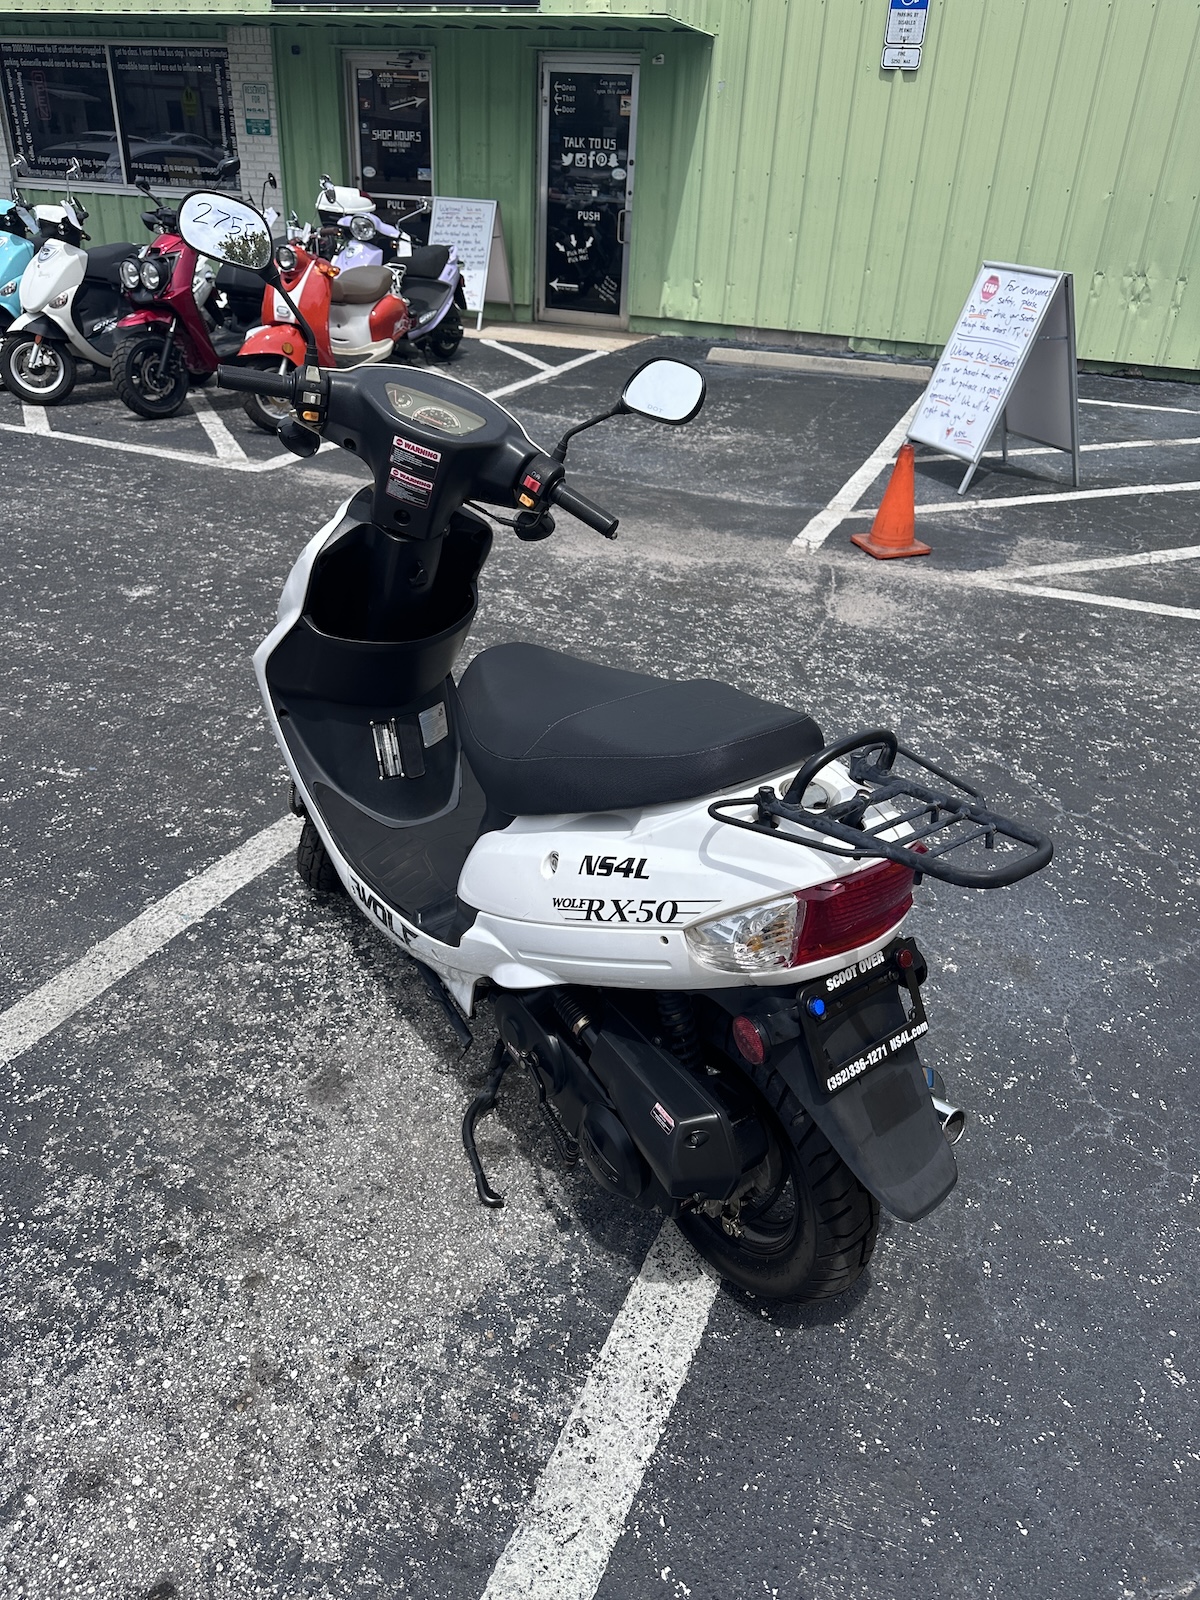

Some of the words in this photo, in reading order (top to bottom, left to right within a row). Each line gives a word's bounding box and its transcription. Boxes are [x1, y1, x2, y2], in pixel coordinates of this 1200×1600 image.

[245, 86, 266, 94] RESERVED
[561, 83, 577, 92] Open
[562, 106, 576, 114] Door
[372, 130, 392, 140] SHOP
[394, 131, 422, 142] HOURS
[563, 136, 586, 149] TALK
[589, 137, 601, 149] TO
[603, 138, 617, 151] US
[387, 200, 406, 210] PULL
[577, 211, 600, 221] PUSH
[983, 282, 998, 294] STOP
[1004, 279, 1020, 292] For
[950, 343, 974, 358] Welcome
[975, 348, 989, 362] back
[647, 404, 664, 413] DOT
[404, 442, 438, 460] WARNING
[400, 473, 431, 489] WARNING
[578, 855, 651, 880] NS4L
[552, 897, 588, 909] WOLF
[585, 899, 679, 924] RX-50
[825, 964, 858, 992] SCOOT
[858, 951, 886, 974] OVER
[826, 1043, 888, 1091] (352)336-1271
[889, 1021, 929, 1052] NS4L.com
